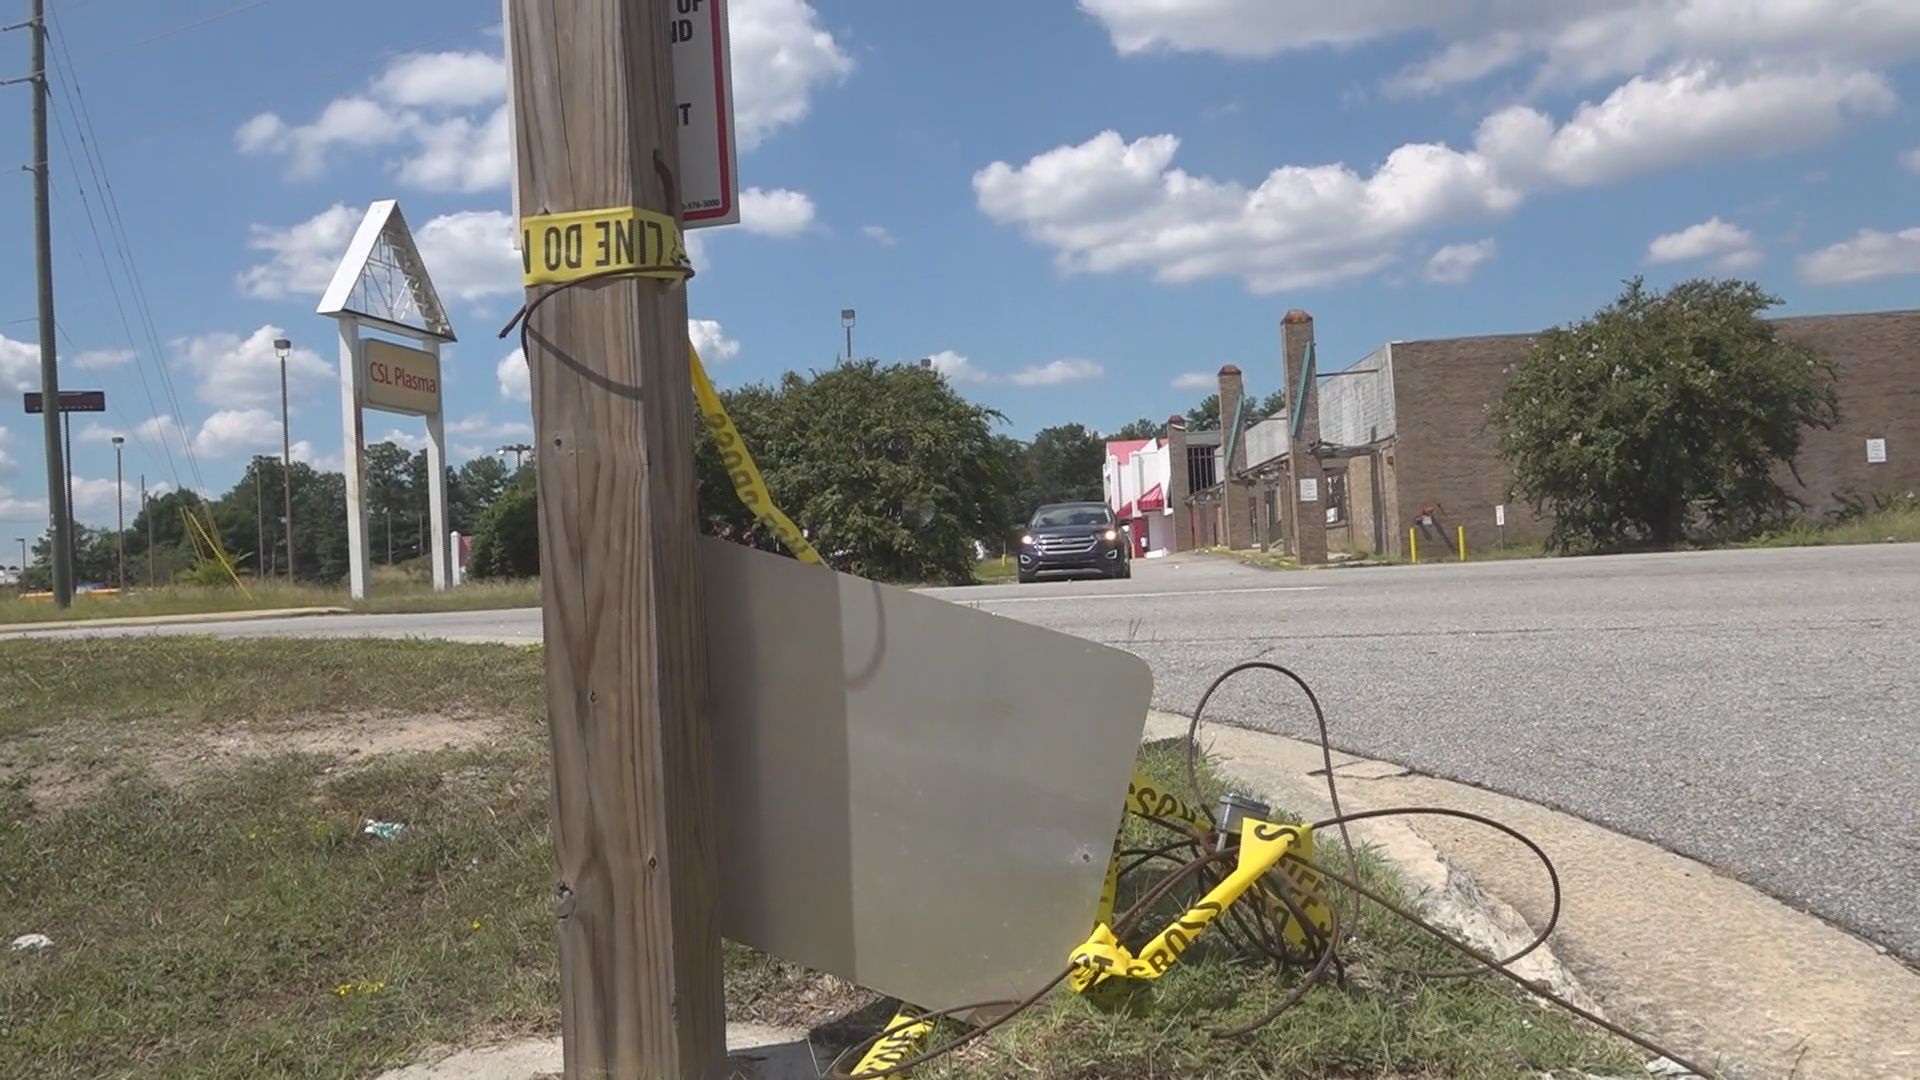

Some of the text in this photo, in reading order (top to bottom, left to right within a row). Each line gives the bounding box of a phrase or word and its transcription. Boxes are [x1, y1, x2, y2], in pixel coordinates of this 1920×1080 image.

[543, 223, 582, 270] DO
[595, 219, 664, 268] LINE
[369, 361, 437, 394] CSL Plasma
